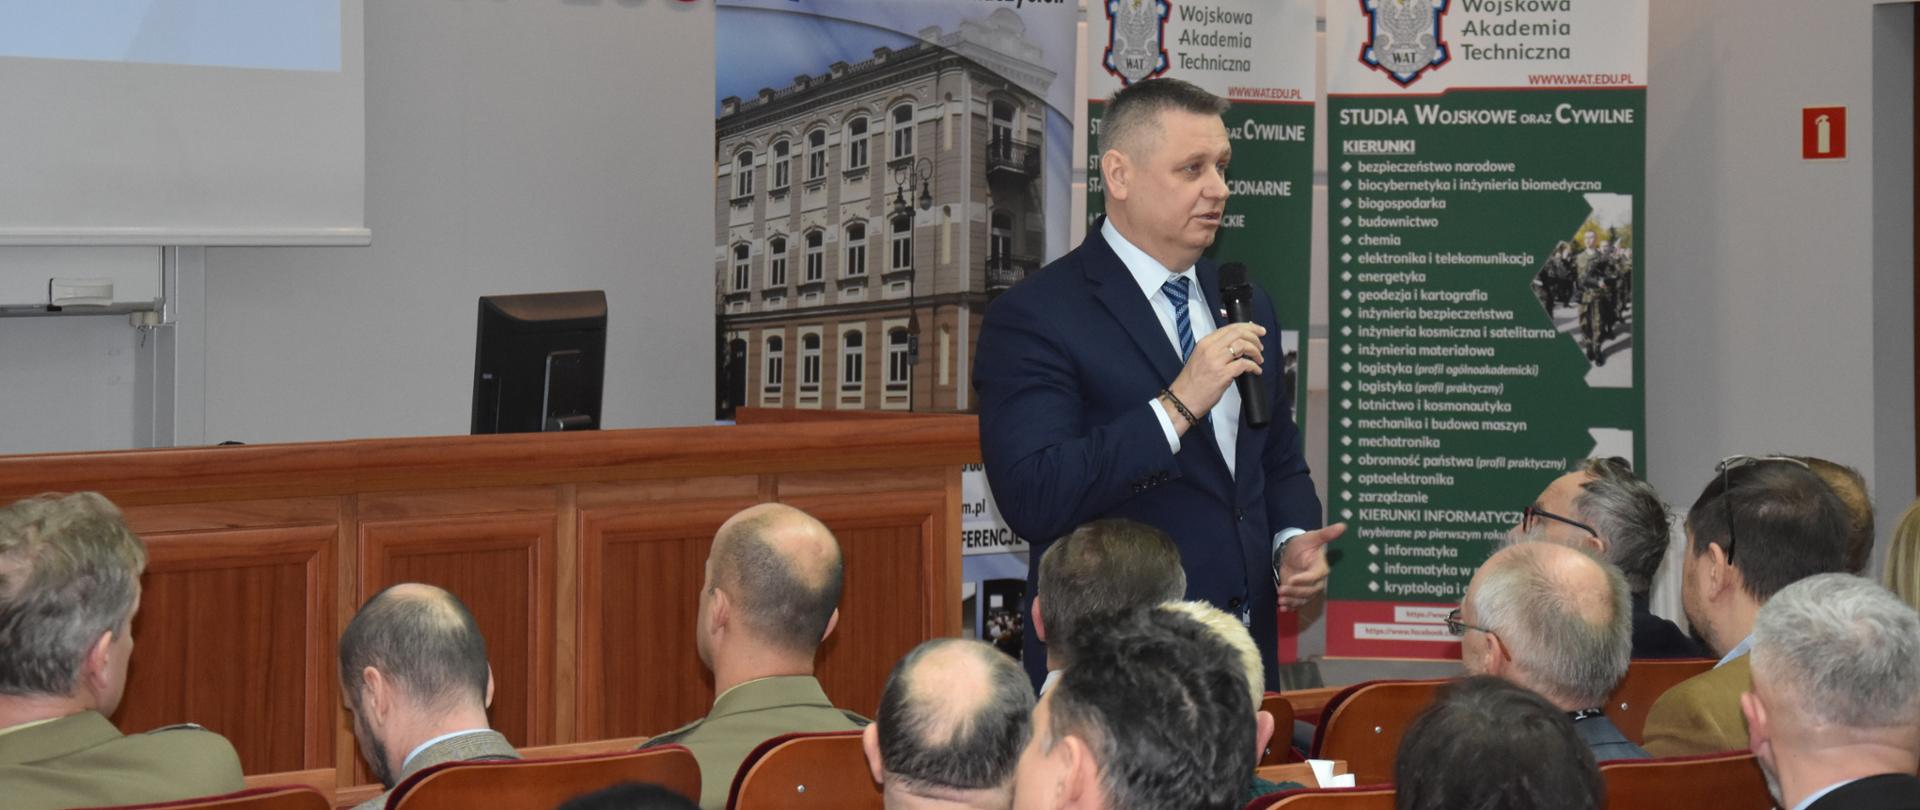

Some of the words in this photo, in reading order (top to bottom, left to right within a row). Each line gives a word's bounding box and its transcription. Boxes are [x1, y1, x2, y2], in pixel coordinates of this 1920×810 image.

[1462, 0, 1571, 16] Wojskowa
[1179, 5, 1253, 26] Wojskowa
[1462, 19, 1570, 37] Akademia
[1179, 29, 1252, 48] Akademia
[1393, 52, 1416, 64] WAT
[1462, 43, 1570, 61] Techniczna
[1126, 58, 1145, 69] WAT
[1178, 53, 1251, 72] Techniczna
[1529, 74, 1634, 85] WWW.WAT.EDU.PL
[1228, 87, 1301, 99] WWW.WAT.EDU.PL
[1340, 108, 1408, 125] STUDIA
[1520, 114, 1552, 124] ORAZ
[1227, 128, 1241, 139] AZ
[1343, 140, 1416, 155] KIERUNKI
[1359, 161, 1452, 175] bezpieczeństwo
[1455, 161, 1516, 173] narodowe
[1229, 181, 1292, 196] CJONARNE
[1359, 179, 1450, 193] biocybernetyka
[1453, 179, 1457, 190] i
[1459, 179, 1519, 193] inżynieria
[1522, 179, 1602, 193] biomedyczna
[1359, 197, 1446, 211] biogospodarka
[1222, 215, 1245, 227] CKIE
[1359, 216, 1438, 227] budownictwo
[1359, 234, 1401, 246] chemia
[1359, 252, 1426, 264] elektronika
[1429, 252, 1433, 264] i
[1435, 252, 1534, 267] telekomunikacja
[1359, 271, 1426, 285] energetyka
[1359, 289, 1412, 303] geodezja
[1415, 289, 1418, 301] i
[1420, 289, 1488, 303] kartografia
[1359, 307, 1417, 321] inżynieria
[1419, 308, 1513, 321] bezpieczeństwa
[1359, 326, 1417, 339] inżynieria
[1419, 326, 1481, 339] kosmiczna
[1484, 326, 1487, 338] i
[1489, 326, 1556, 339] satelitarna
[1359, 344, 1417, 359] inżynieria
[1419, 344, 1495, 357] materiałowa
[1359, 362, 1412, 376] logistyka
[1415, 364, 1444, 376] (profil
[1446, 364, 1539, 377] ogólnoakademicki)
[1359, 380, 1412, 394] logistyka
[1415, 383, 1444, 394] (profil
[1446, 383, 1504, 395] praktyczny)
[1359, 400, 1415, 412] lotnictwo
[1417, 400, 1421, 412] i
[1424, 400, 1512, 414] kosmonautyka
[1359, 418, 1423, 430] mechanika
[1425, 418, 1429, 430] i
[1432, 418, 1479, 431] budowa
[1481, 420, 1527, 434] maszyn
[1359, 436, 1440, 449] mechatronika
[1359, 454, 1421, 468] obronność
[1423, 455, 1474, 470] państwa
[1476, 456, 1505, 470] (profil
[1508, 457, 1566, 471] praktyczny)
[1359, 473, 1454, 487] optoelektronika
[1359, 491, 1428, 506] zarządzanie
[1359, 510, 1421, 522] KIERUNKI
[962, 529, 1022, 548] FERENCJE
[1358, 527, 1412, 540] (wybierane
[1415, 530, 1427, 540] po
[1429, 529, 1481, 542] pierwszym
[1385, 545, 1458, 559] informatyka
[1385, 563, 1458, 578] informatyka
[1460, 566, 1471, 576] w
[1385, 581, 1454, 596] kryptologia
[1456, 581, 1460, 593] i
